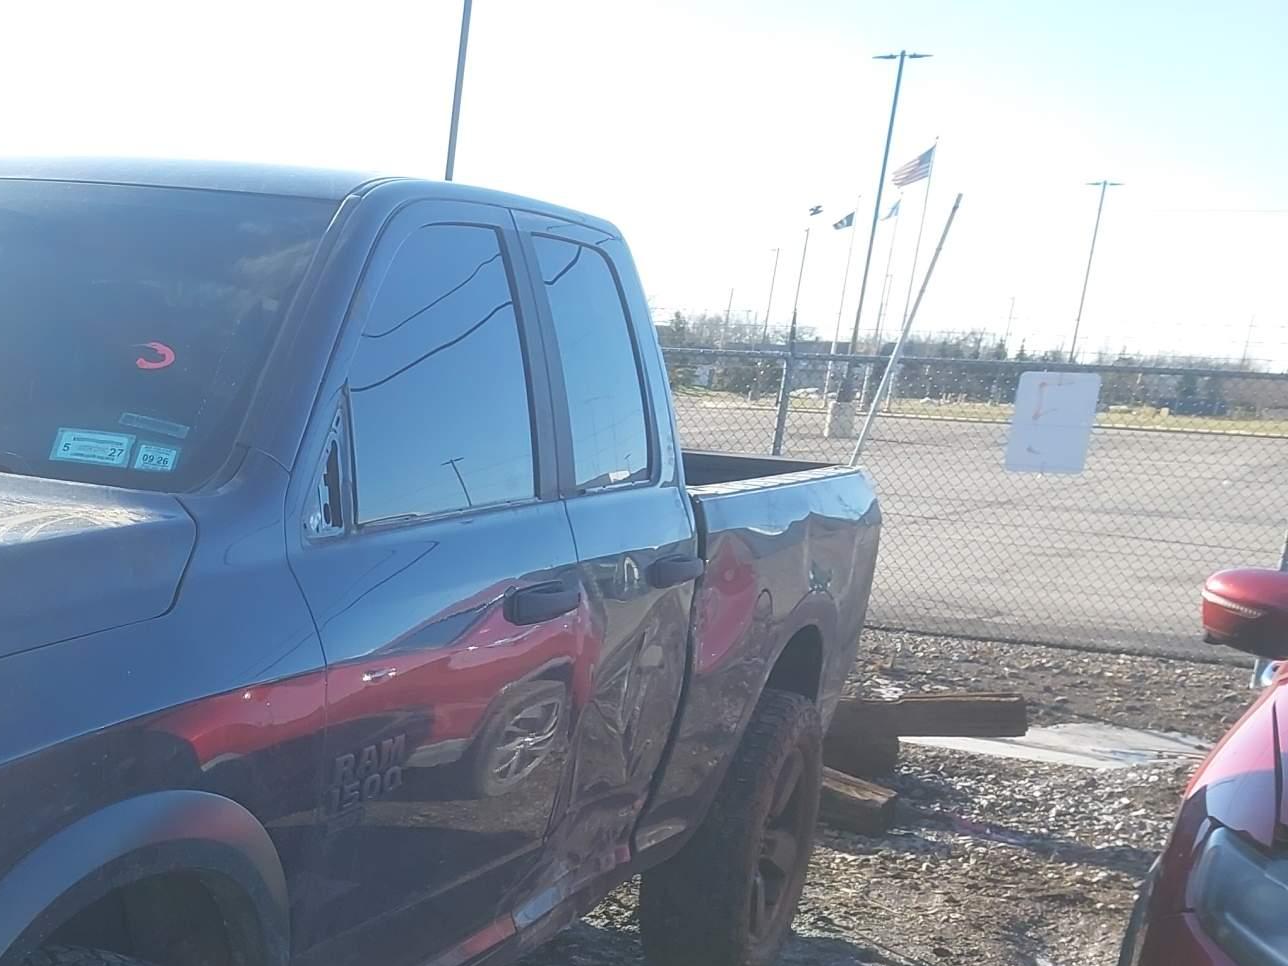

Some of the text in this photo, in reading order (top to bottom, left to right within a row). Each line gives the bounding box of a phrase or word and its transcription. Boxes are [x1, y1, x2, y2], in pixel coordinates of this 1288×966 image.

[62, 442, 72, 452] 5
[108, 447, 124, 458] 27
[142, 453, 169, 465] 09 26
[333, 732, 407, 783] RAM
[325, 765, 402, 815] 1500
